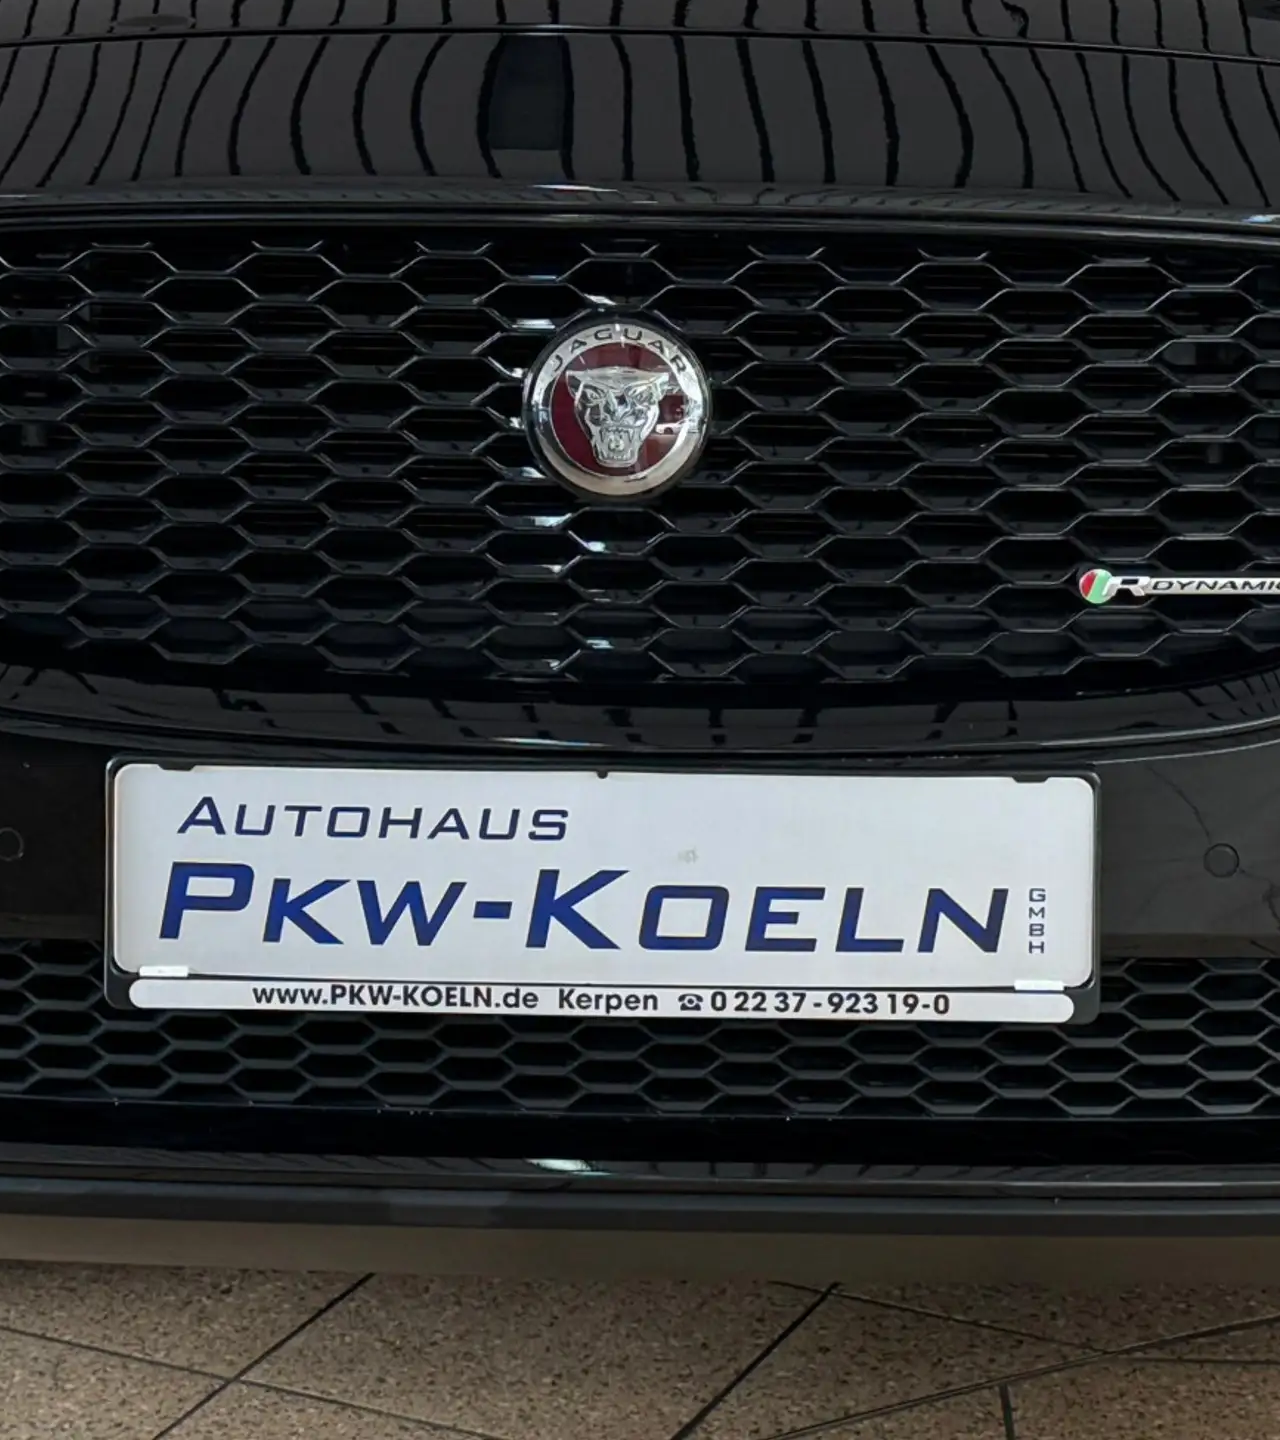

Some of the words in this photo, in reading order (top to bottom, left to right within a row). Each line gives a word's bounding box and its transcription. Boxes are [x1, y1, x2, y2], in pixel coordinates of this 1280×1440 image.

[551, 328, 686, 374] JAGUAR
[177, 796, 569, 841] AUTOHAUS
[159, 861, 1009, 954] PKW-KOELN
[252, 984, 539, 1009] www.PKW-KOELN.de
[558, 988, 659, 1013] Kerpen
